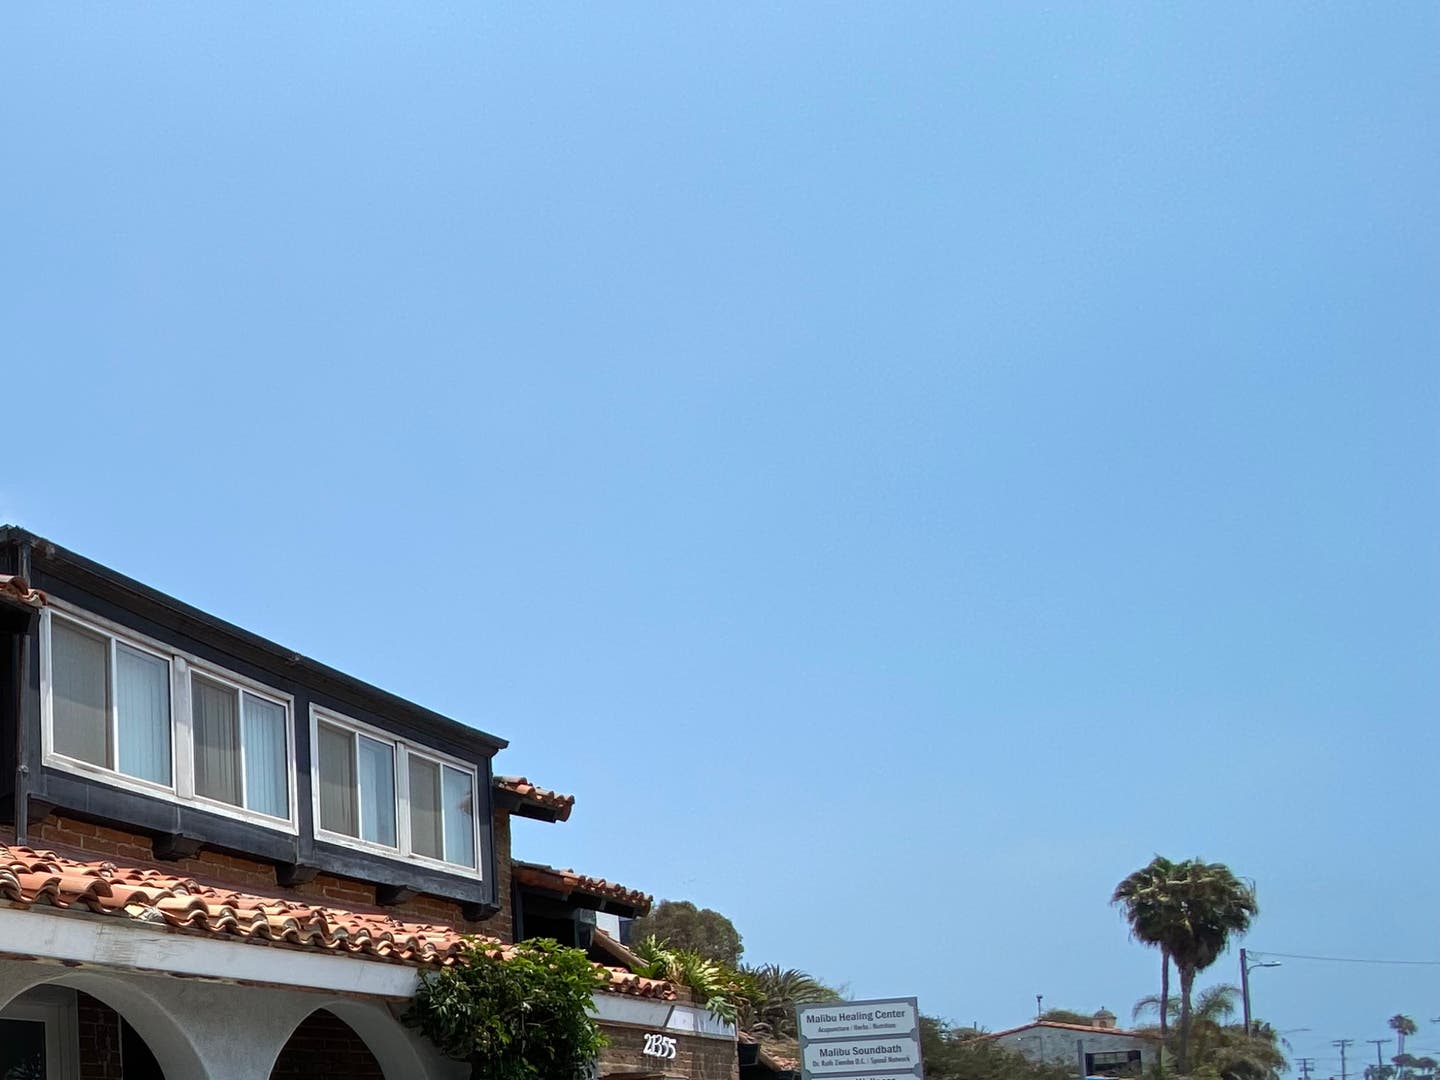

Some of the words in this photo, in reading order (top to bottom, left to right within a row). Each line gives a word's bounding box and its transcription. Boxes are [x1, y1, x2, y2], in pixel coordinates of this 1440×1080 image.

[806, 1013, 837, 1023] Malibu
[839, 1011, 873, 1021] Healing
[875, 1010, 905, 1019] Center
[819, 1048, 850, 1057] Malibu
[852, 1044, 902, 1055] Soundbath
